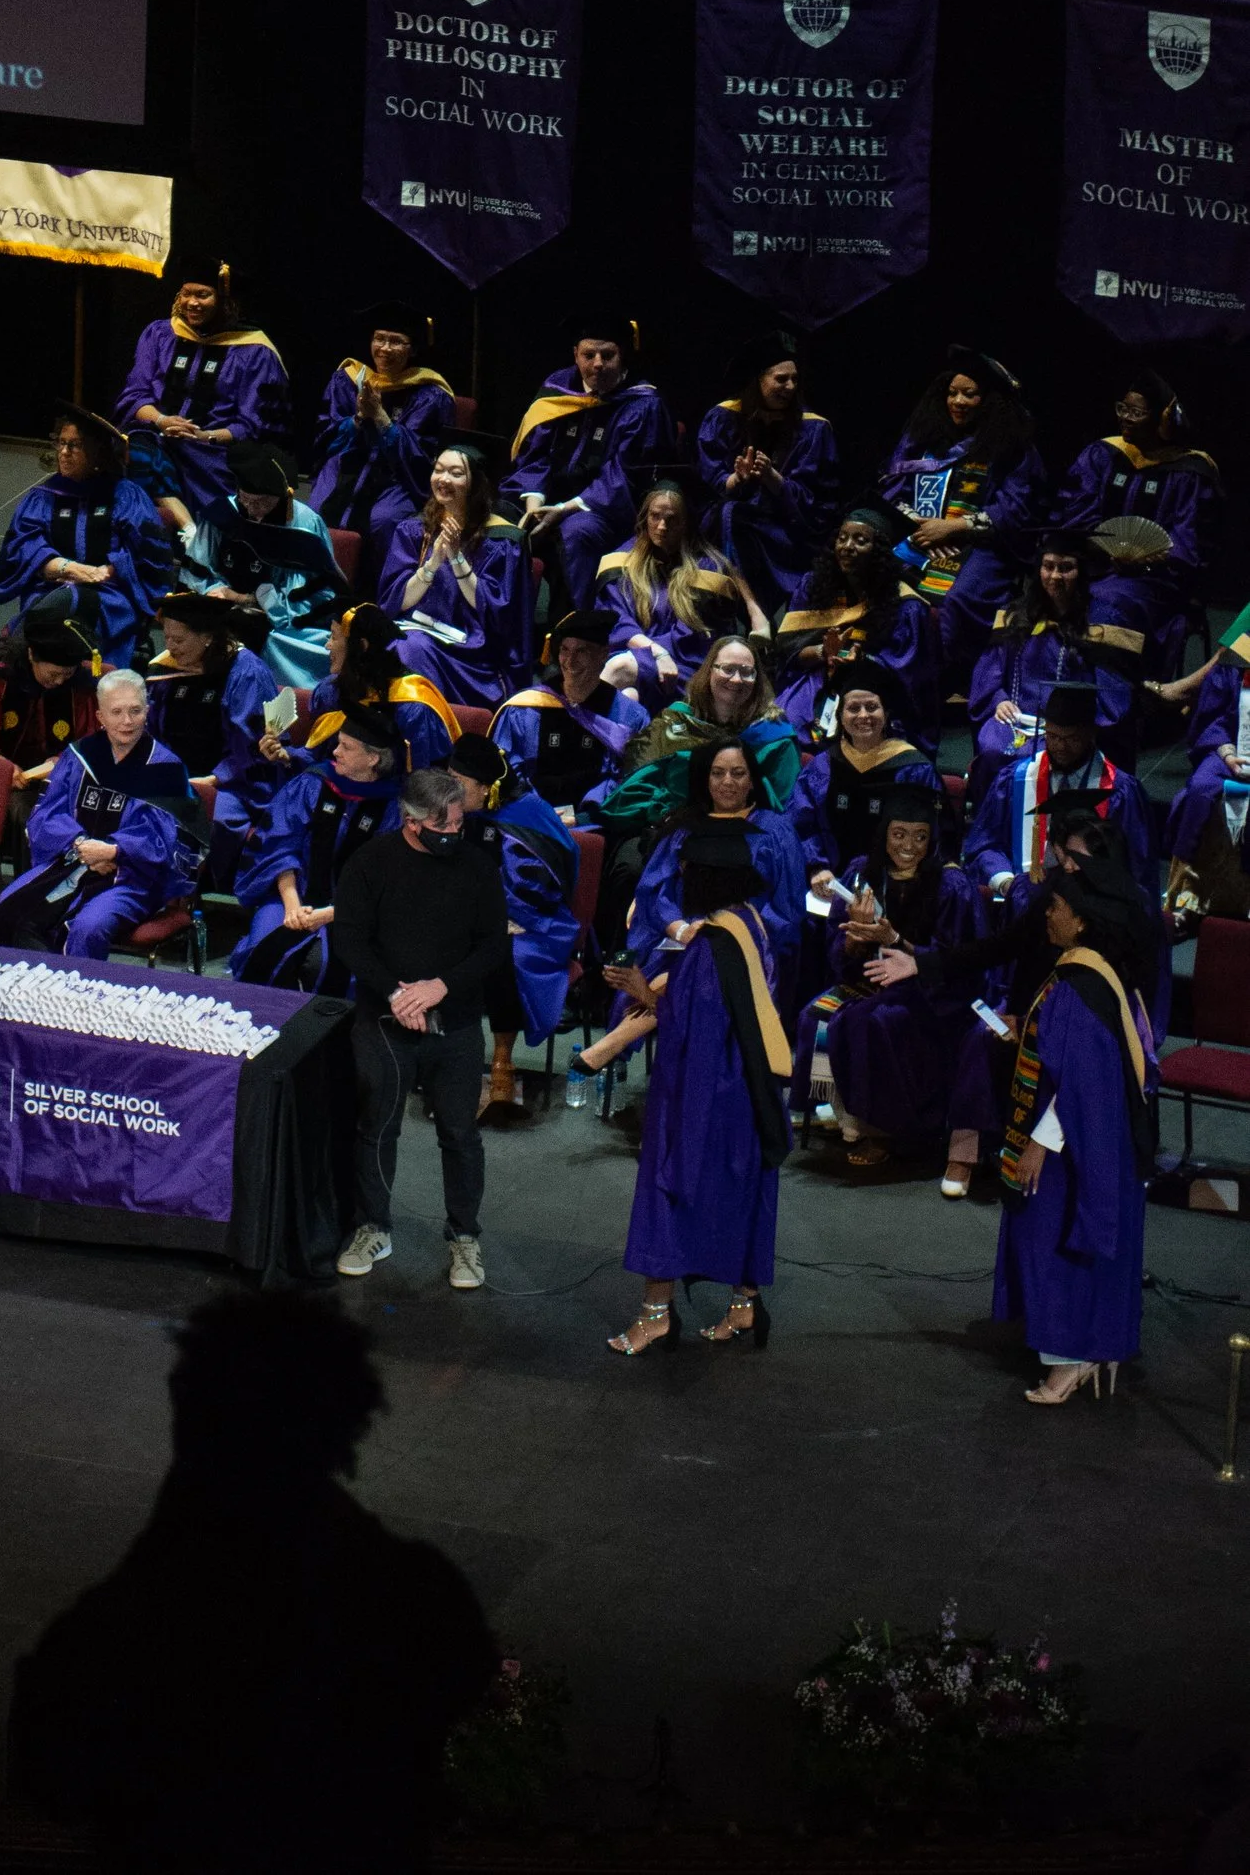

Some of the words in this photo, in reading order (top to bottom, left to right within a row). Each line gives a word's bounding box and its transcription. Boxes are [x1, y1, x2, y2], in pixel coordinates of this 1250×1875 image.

[394, 11, 511, 44] DOCTOR
[519, 27, 558, 49] OF
[385, 38, 567, 79] PHILOSOPHY
[460, 75, 486, 100] IN
[723, 75, 855, 99] DOCTOR
[866, 78, 907, 99] OF
[385, 96, 475, 127] SOCIAL
[481, 108, 565, 138] WORK
[757, 105, 873, 128] SOCIAL
[738, 133, 889, 157] WELFARE
[1118, 127, 1235, 163] MASTER
[741, 161, 767, 180] IN
[775, 163, 887, 182] CLINICAL
[1156, 163, 1193, 186] OF
[430, 188, 467, 208] NYU
[473, 195, 501, 206] SILVER
[502, 199, 534, 211] SCHOOL
[732, 186, 818, 206] SOCIAL
[825, 189, 895, 208] WORK
[1082, 181, 1176, 215] SOCIAL
[1183, 195, 1250, 225] WOR
[11, 208, 62, 235] YORK
[473, 203, 484, 212] OF
[485, 205, 515, 217] SOCIAL
[516, 209, 542, 221] WORK
[763, 235, 807, 252] NYU
[1122, 279, 1162, 300] NYU
[24, 1081, 86, 1105] SILVER
[90, 1091, 165, 1117] SCHOOL
[23, 1099, 49, 1116] OF
[53, 1103, 120, 1128] SOCIAL
[123, 1113, 181, 1137] WORK
